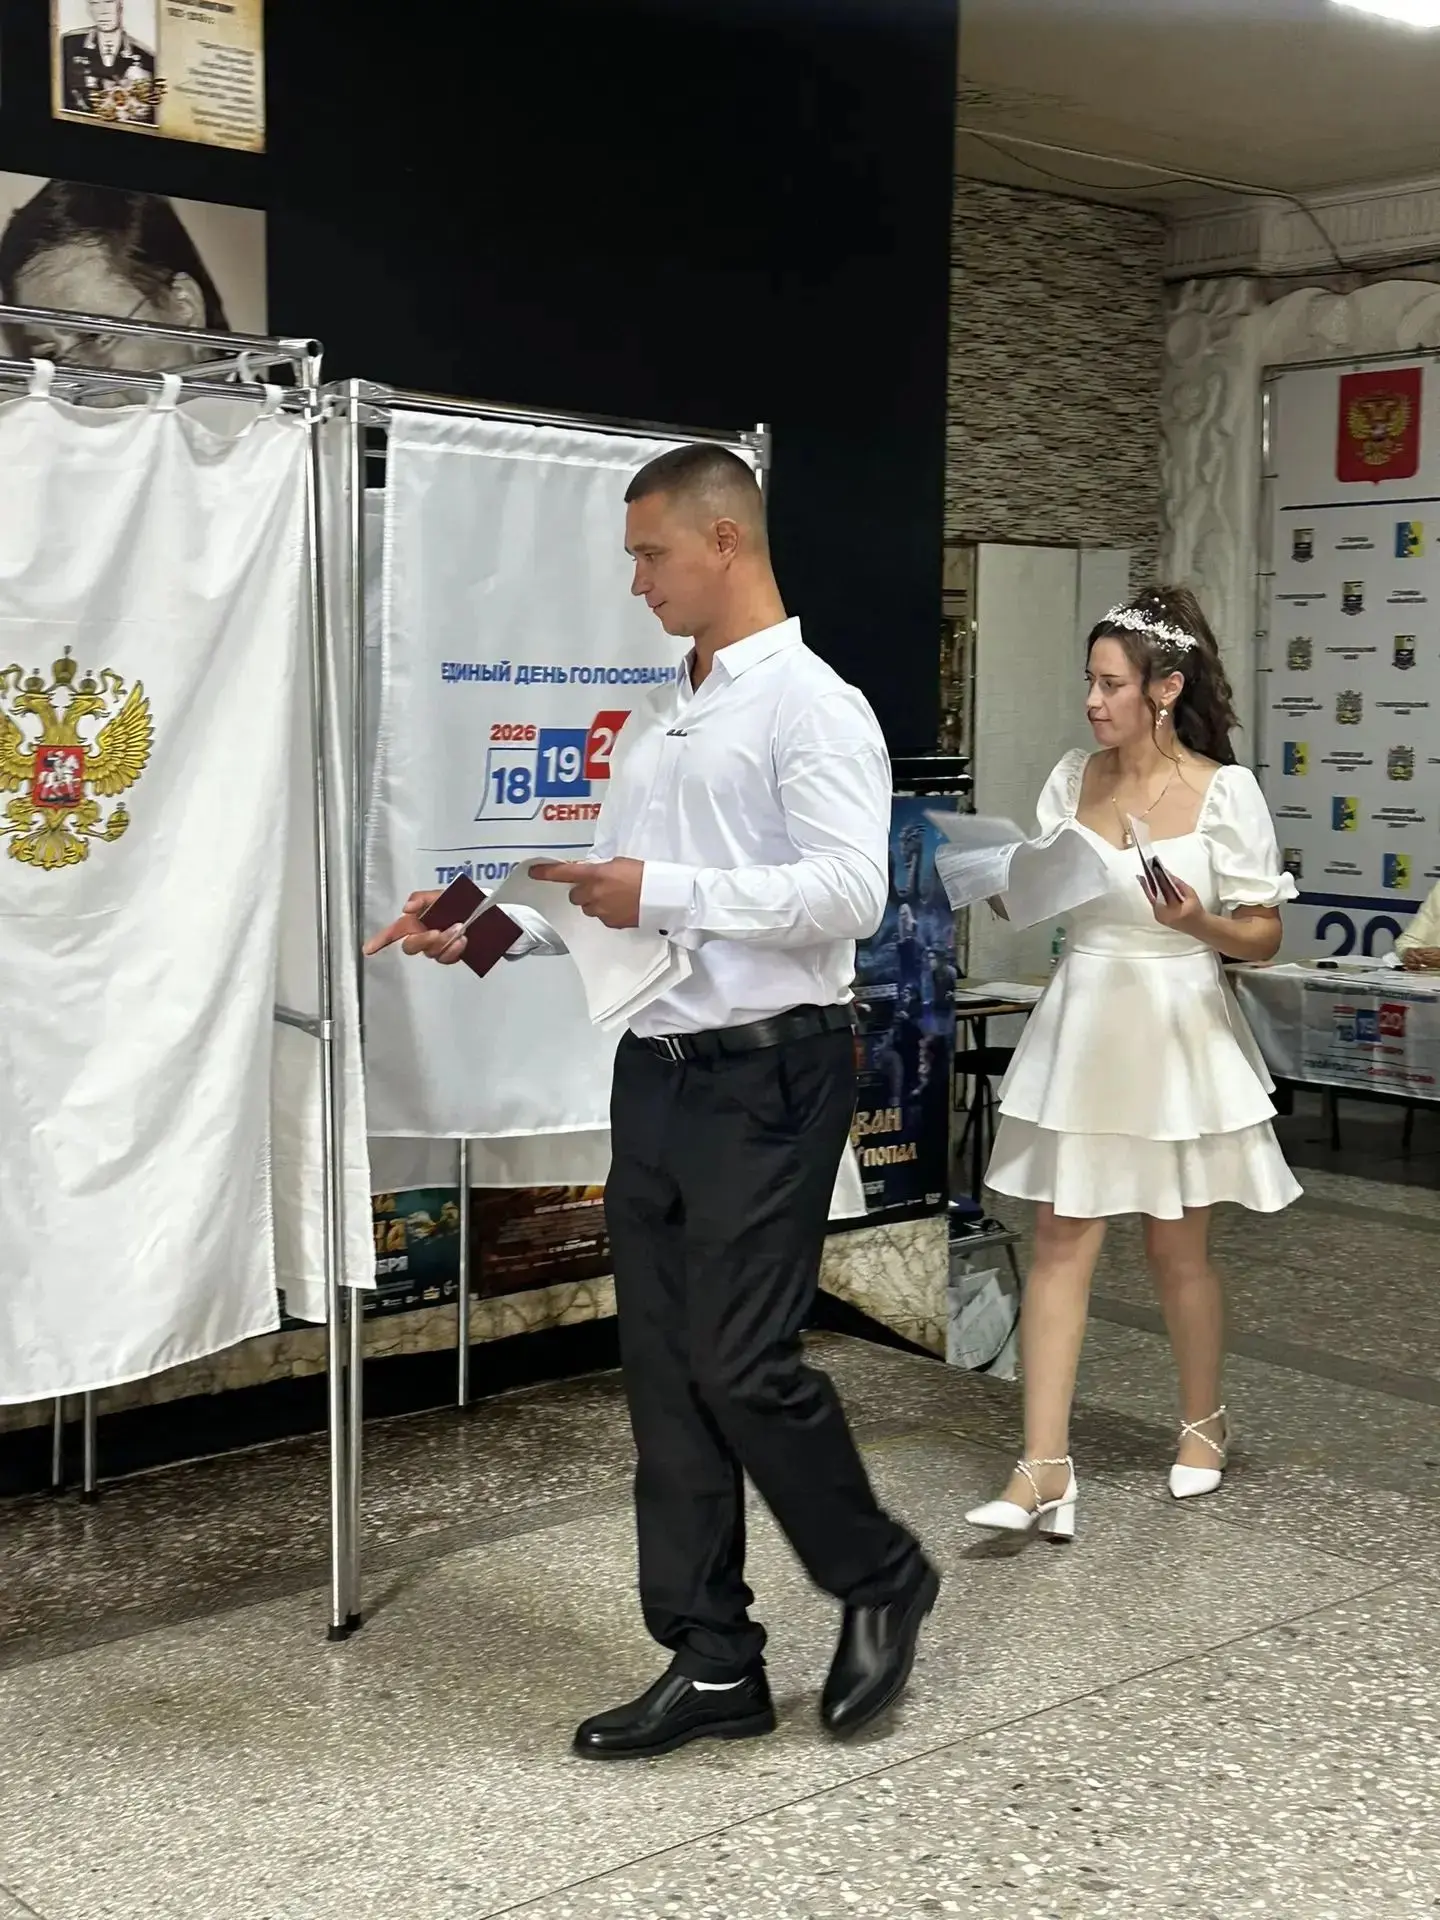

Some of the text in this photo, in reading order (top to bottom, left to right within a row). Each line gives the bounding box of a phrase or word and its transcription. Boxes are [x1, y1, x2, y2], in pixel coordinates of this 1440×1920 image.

[441, 660, 512, 682] ЕДИНЫЙ
[514, 665, 568, 684] ДЕНЬ
[489, 724, 537, 741] 2026
[491, 727, 613, 804] 18 19 2
[543, 803, 602, 821] СЕНТЯ
[851, 1107, 902, 1138] ВАН
